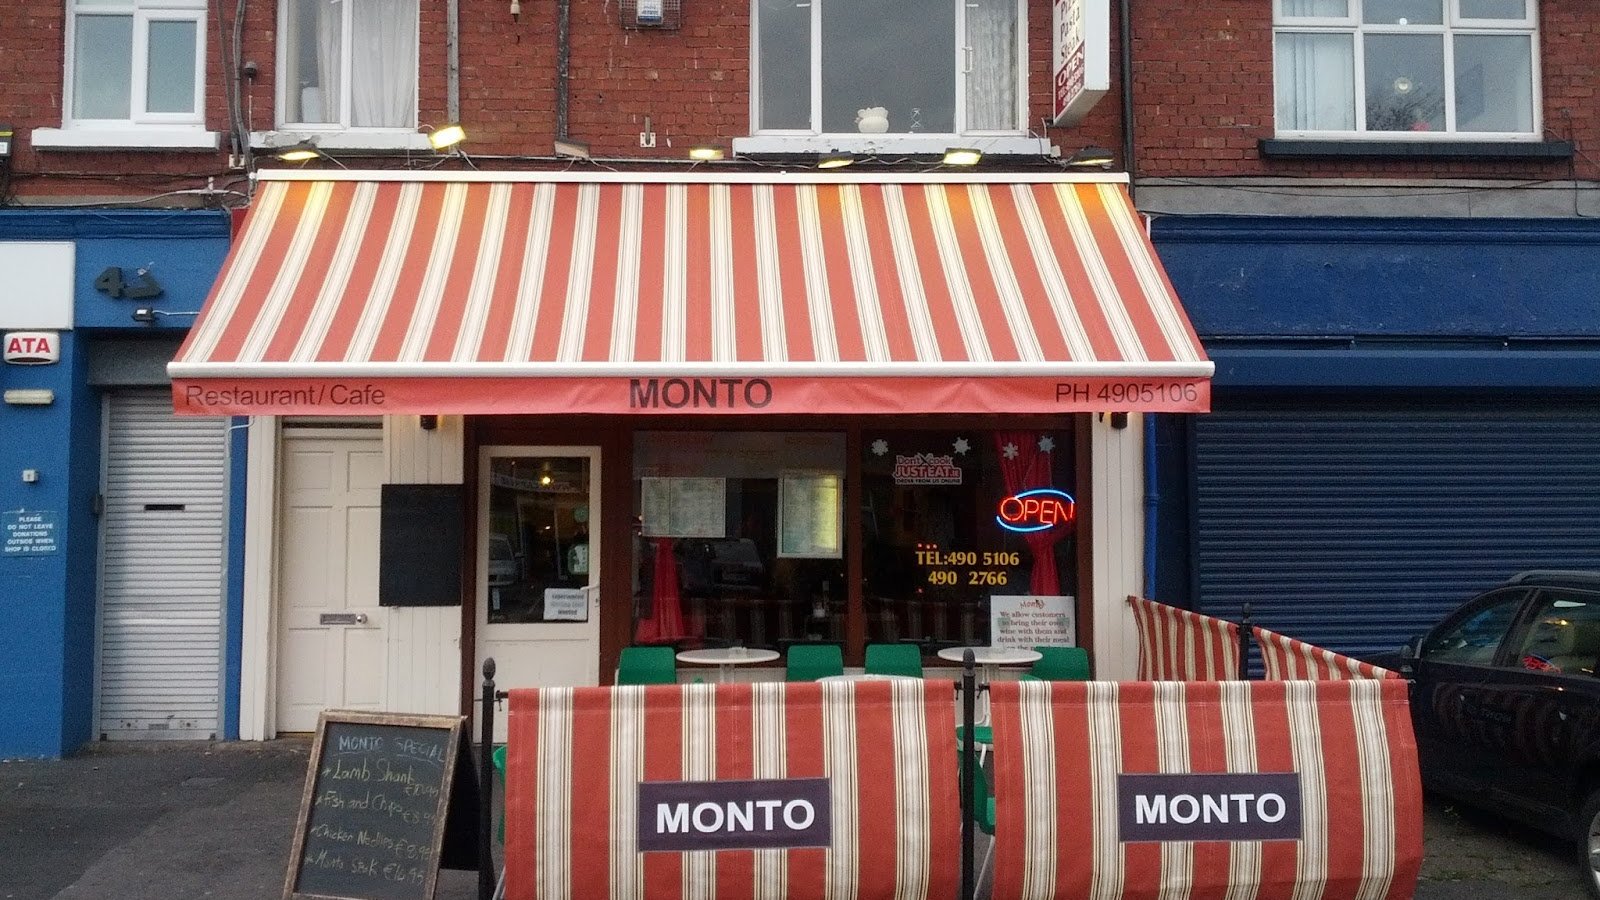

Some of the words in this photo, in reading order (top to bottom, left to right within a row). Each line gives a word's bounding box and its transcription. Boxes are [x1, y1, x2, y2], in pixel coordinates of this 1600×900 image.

[1058, 46, 1084, 87] OPEN
[7, 337, 51, 353] ATA
[330, 384, 385, 405] Cafe
[629, 378, 773, 409] MONTO
[1056, 383, 1090, 403] PH
[1096, 383, 1198, 403] 4905106
[1000, 497, 1074, 525] OPEN
[982, 552, 1020, 566] 5106
[928, 571, 958, 585] 490
[968, 571, 1008, 585] 2766
[393, 738, 445, 764] SPECIAL
[332, 757, 371, 781] Lamb
[376, 758, 415, 785] Shank
[348, 791, 370, 810] and
[371, 795, 404, 818] Chips
[656, 799, 816, 834] MONTO
[1135, 793, 1287, 825] MONTO
